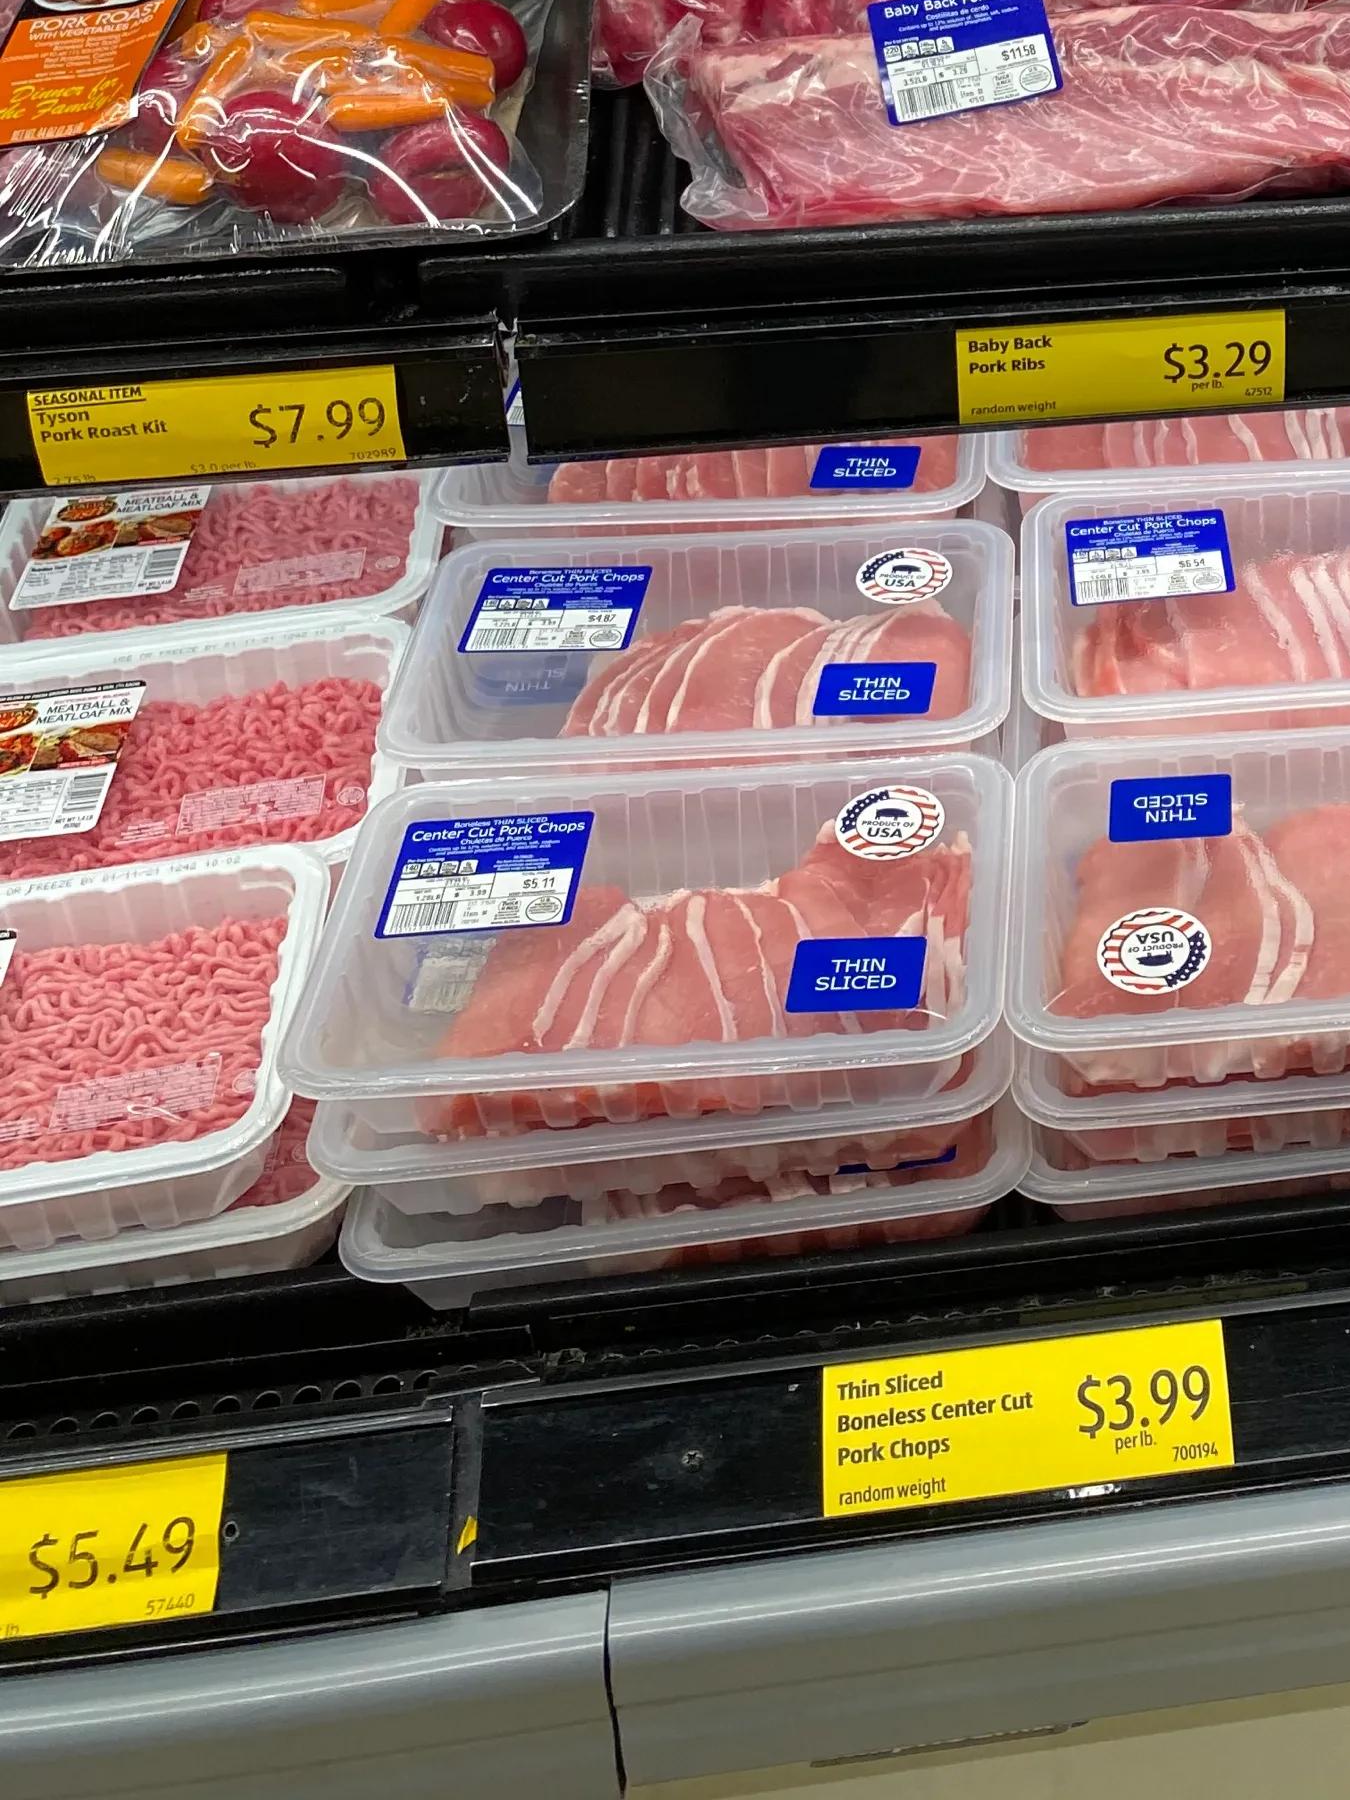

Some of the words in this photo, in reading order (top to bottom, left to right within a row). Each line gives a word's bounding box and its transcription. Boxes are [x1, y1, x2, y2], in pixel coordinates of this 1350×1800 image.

[30, 14, 89, 34] PORK
[95, 1, 166, 26] ROAST
[884, 3, 919, 19] Baby
[968, 338, 1009, 355] Baby
[1014, 335, 1053, 350] Back
[969, 360, 1006, 374] Pork
[1012, 357, 1046, 372] Ribs
[1164, 340, 1272, 383] $3.29
[34, 388, 106, 406] SEASONAL
[109, 386, 142, 400] ITEM
[1245, 387, 1273, 397] 47512
[36, 408, 90, 427] Tyson
[970, 404, 1016, 416] random
[1017, 401, 1056, 415] weight
[41, 426, 88, 443] Pork
[91, 422, 140, 441] Roast
[143, 420, 168, 436] Kit
[248, 396, 387, 449] $7.99
[847, 458, 889, 467] THIN
[833, 468, 896, 477] SLICED
[1070, 527, 1115, 537] Center
[1118, 524, 1141, 533] Cut
[1144, 521, 1173, 531] Pork
[1177, 516, 1217, 528] Chops
[884, 578, 916, 588] USA
[853, 678, 900, 688] THIN
[839, 689, 910, 701] SLICED
[35, 708, 108, 725] MEATLOAF
[111, 704, 134, 717] MIX
[1134, 794, 1208, 808] SLICED
[1145, 809, 1196, 823] THIN
[412, 830, 464, 842] Center
[468, 826, 495, 838] Cut
[500, 825, 533, 836] Pork
[538, 821, 586, 835] Chops
[867, 826, 904, 839] USA
[1136, 932, 1174, 943] USA
[1128, 945, 1140, 953] OF
[1145, 943, 1184, 953] PRODUCT
[832, 958, 886, 973] THIN
[815, 975, 897, 991] SLICED
[837, 1380, 880, 1401] Thin
[885, 1371, 943, 1396] Sliced
[1077, 1365, 1211, 1439] $3.99
[837, 1407, 926, 1433] Boneless
[931, 1397, 996, 1421] Center
[1001, 1391, 1033, 1411] Cut
[837, 1443, 886, 1466] Pork
[890, 1435, 950, 1461] Chops
[1115, 1435, 1139, 1454] per
[1140, 1429, 1157, 1448] lb.
[1172, 1443, 1219, 1462] 700194
[839, 1485, 895, 1507] random
[897, 1477, 947, 1500] weight
[28, 1516, 196, 1599] $5.49
